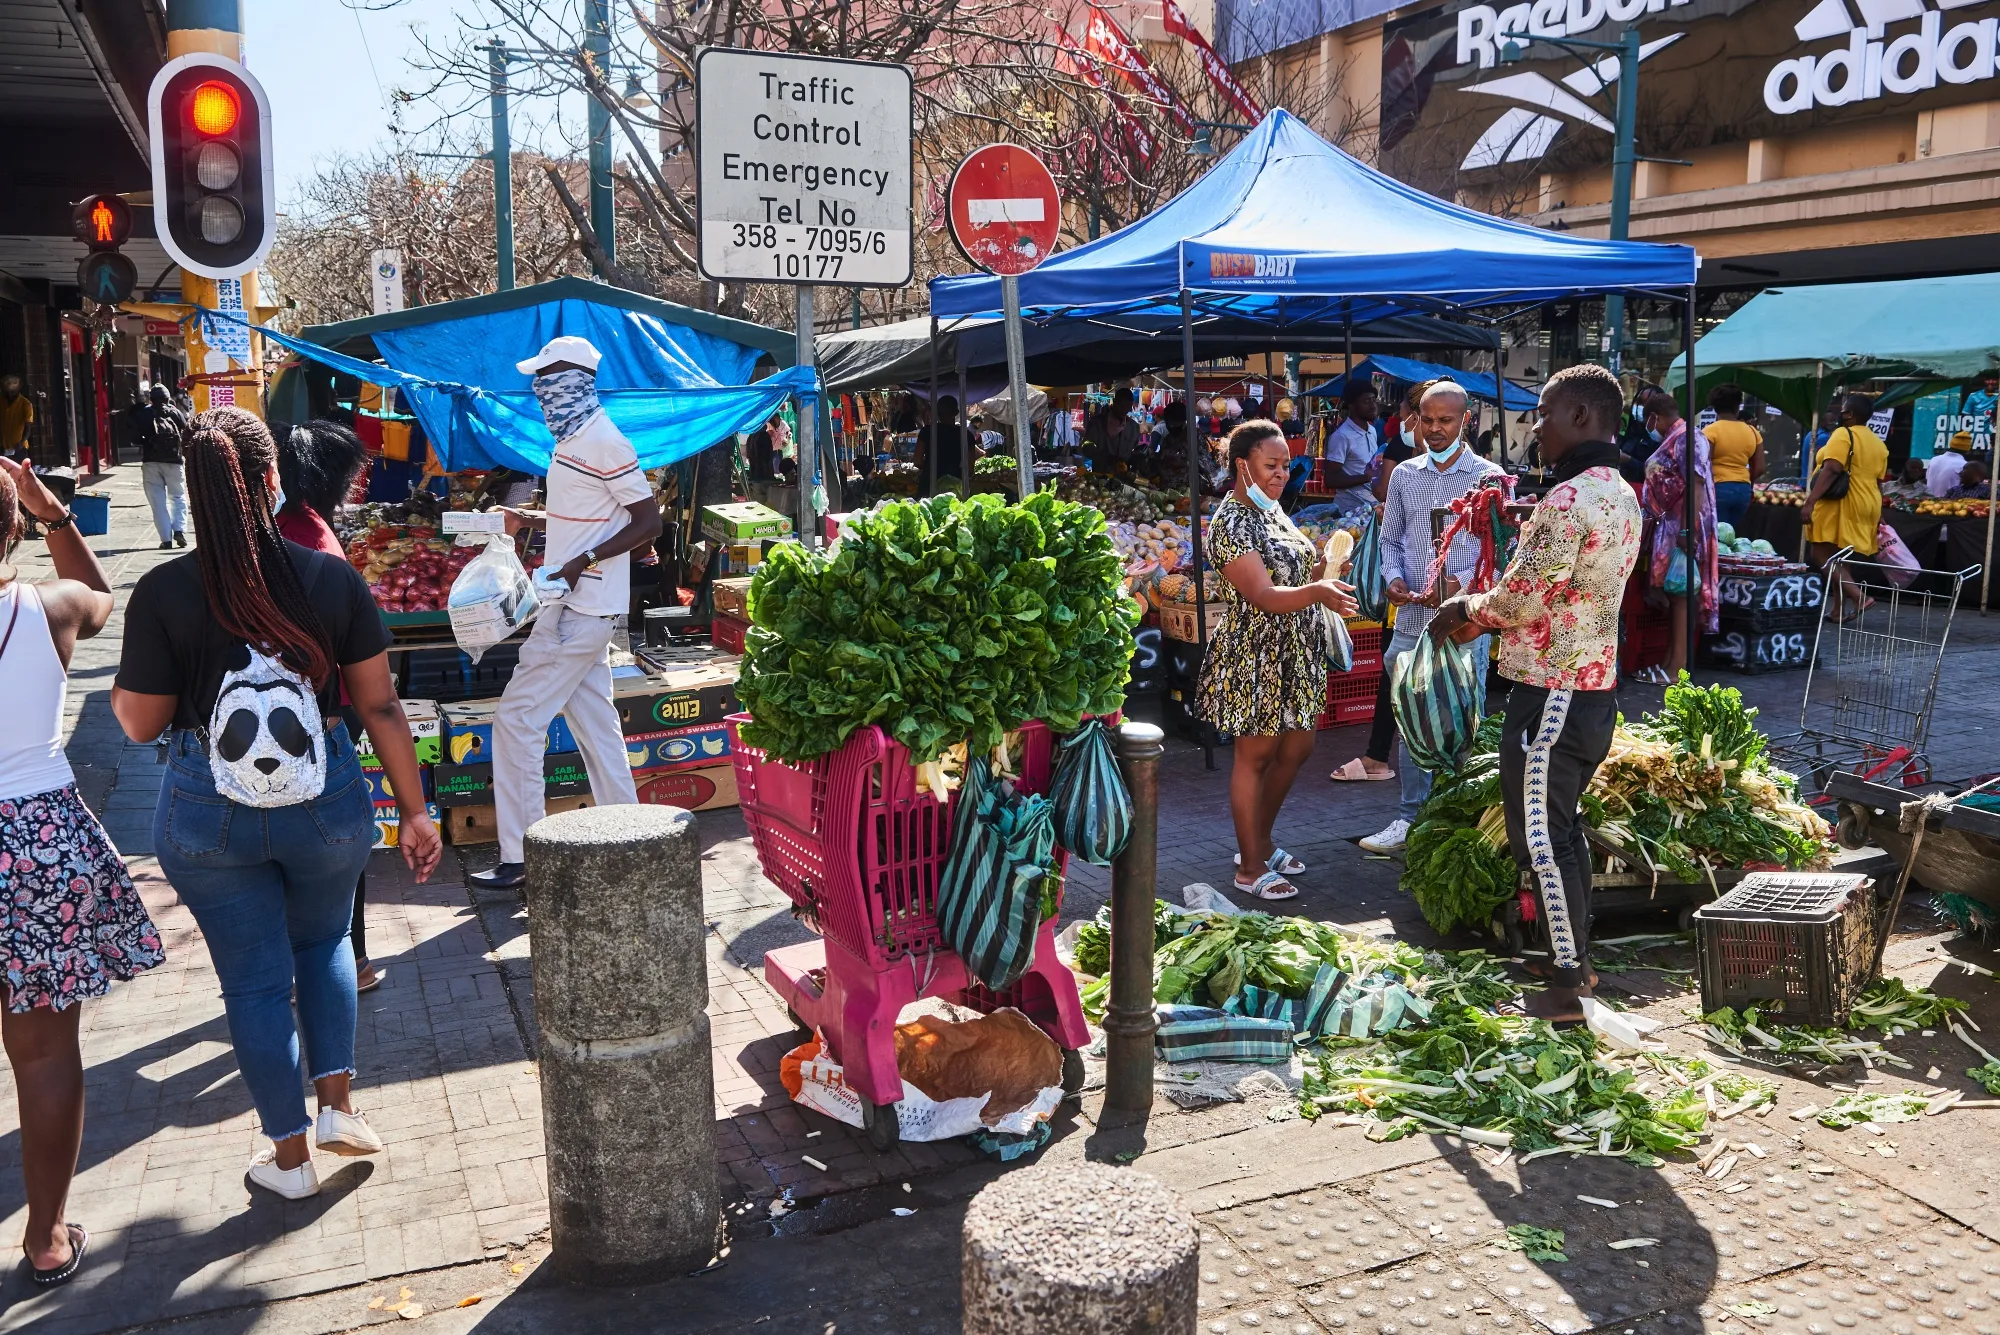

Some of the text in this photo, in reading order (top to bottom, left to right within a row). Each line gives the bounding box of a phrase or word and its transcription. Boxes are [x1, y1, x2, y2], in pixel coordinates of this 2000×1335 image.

[1763, 10, 2000, 115] adida
[759, 72, 854, 105] Traffic
[753, 113, 861, 147] Control
[723, 152, 889, 196] Emergency
[759, 196, 856, 226] Tel No
[732, 223, 777, 249] 358
[806, 227, 886, 255] 7095/6
[773, 253, 843, 279] 10177
[1936, 414, 1986, 432] ONCE
[662, 699, 700, 719] Elite
[644, 729, 684, 741] BANANAS
[450, 775, 472, 785] SABI
[554, 766, 576, 775] SABI
[437, 782, 485, 794] BANANAS
[659, 789, 691, 801] BANANAS
